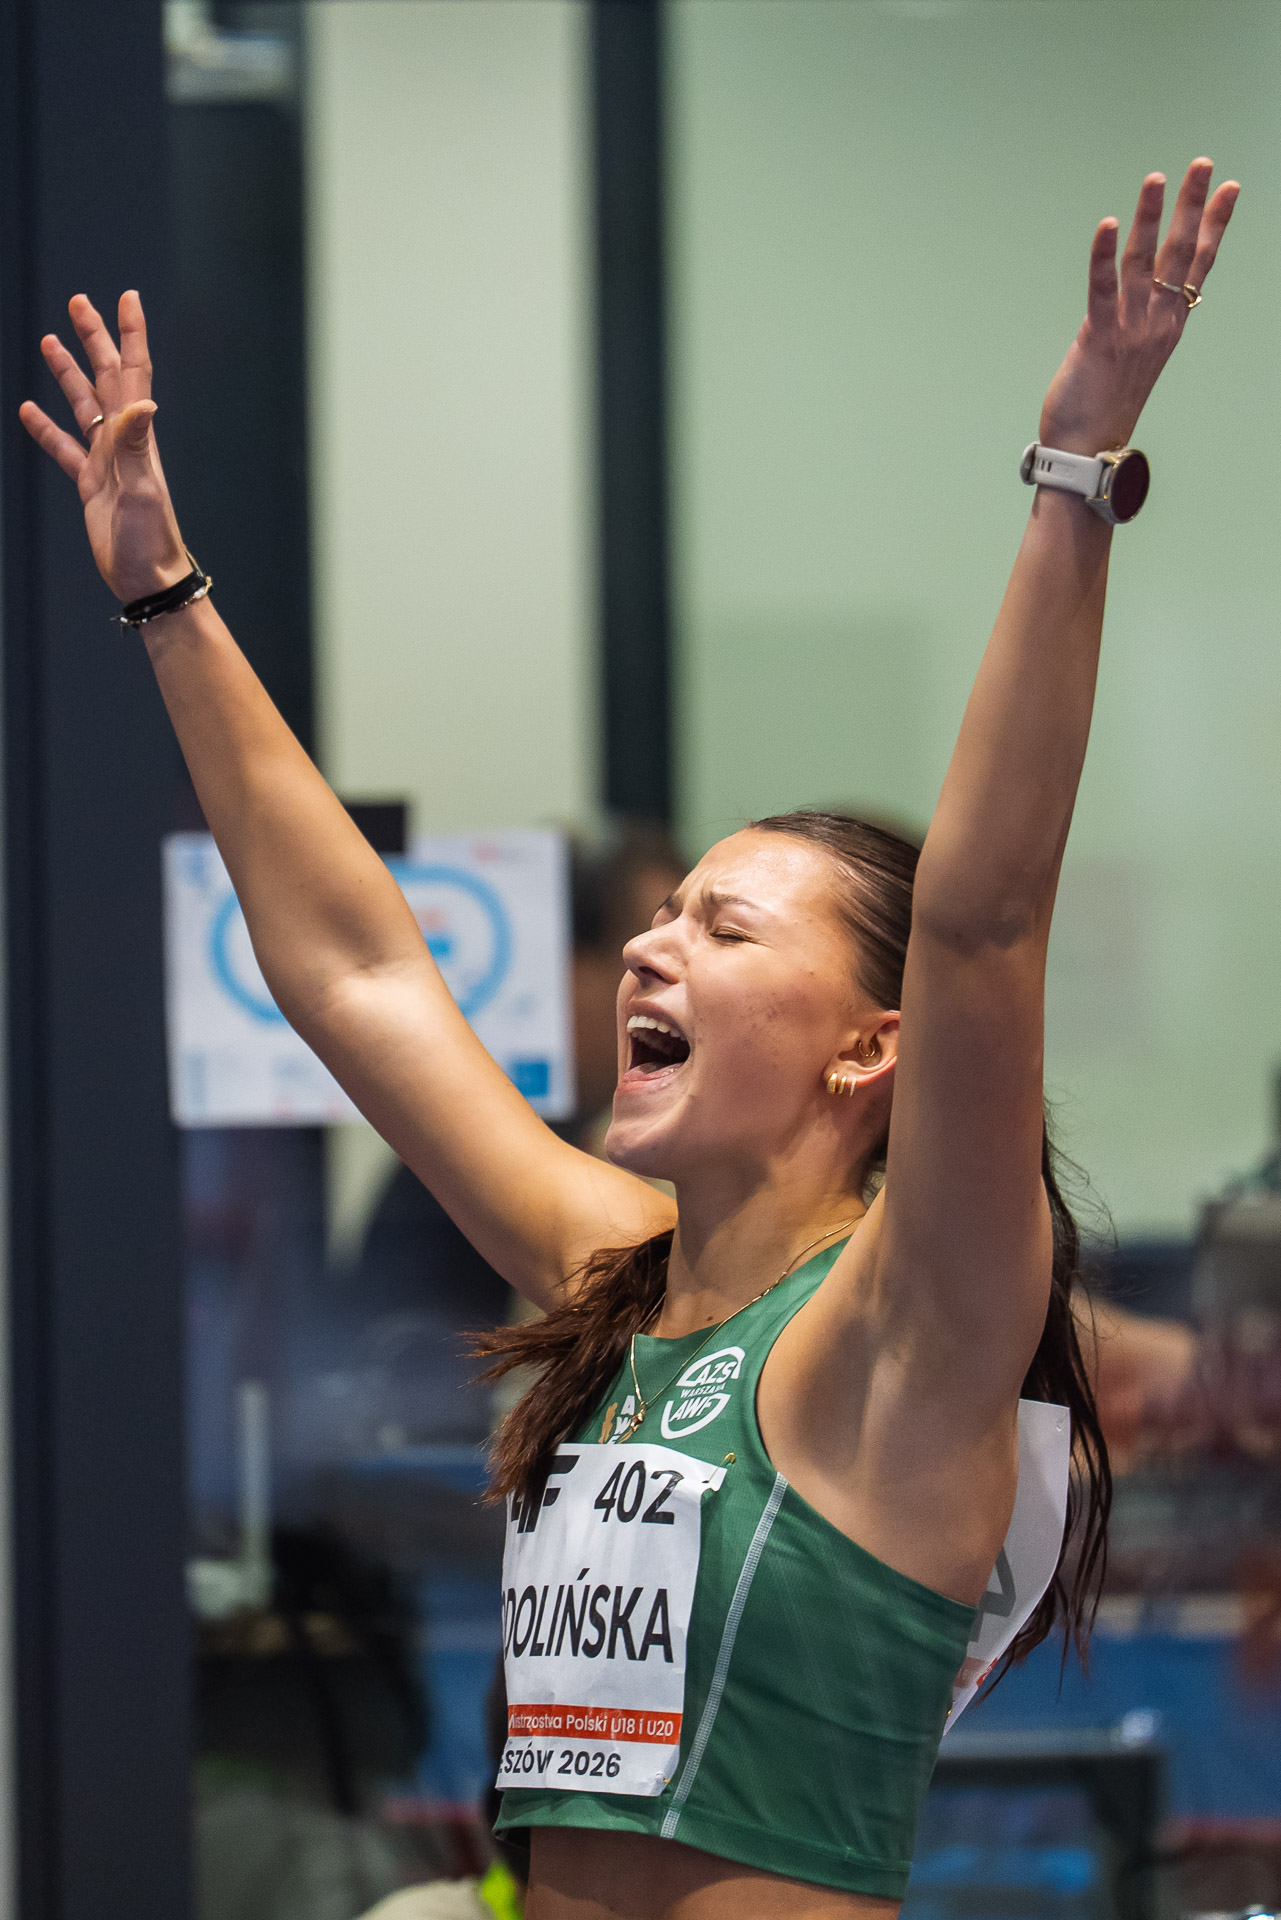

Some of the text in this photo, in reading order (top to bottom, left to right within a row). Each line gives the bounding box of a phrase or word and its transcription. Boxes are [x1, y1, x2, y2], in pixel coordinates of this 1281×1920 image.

[695, 1361, 738, 1385] AZS
[669, 1397, 713, 1422] AWF
[593, 1460, 685, 1525] 402
[502, 1567, 674, 1663] DOLIŃSKA
[566, 1714, 607, 1732] Polski
[611, 1717, 636, 1735] U18
[647, 1720, 674, 1737] U20
[557, 1750, 621, 1777] 2026
